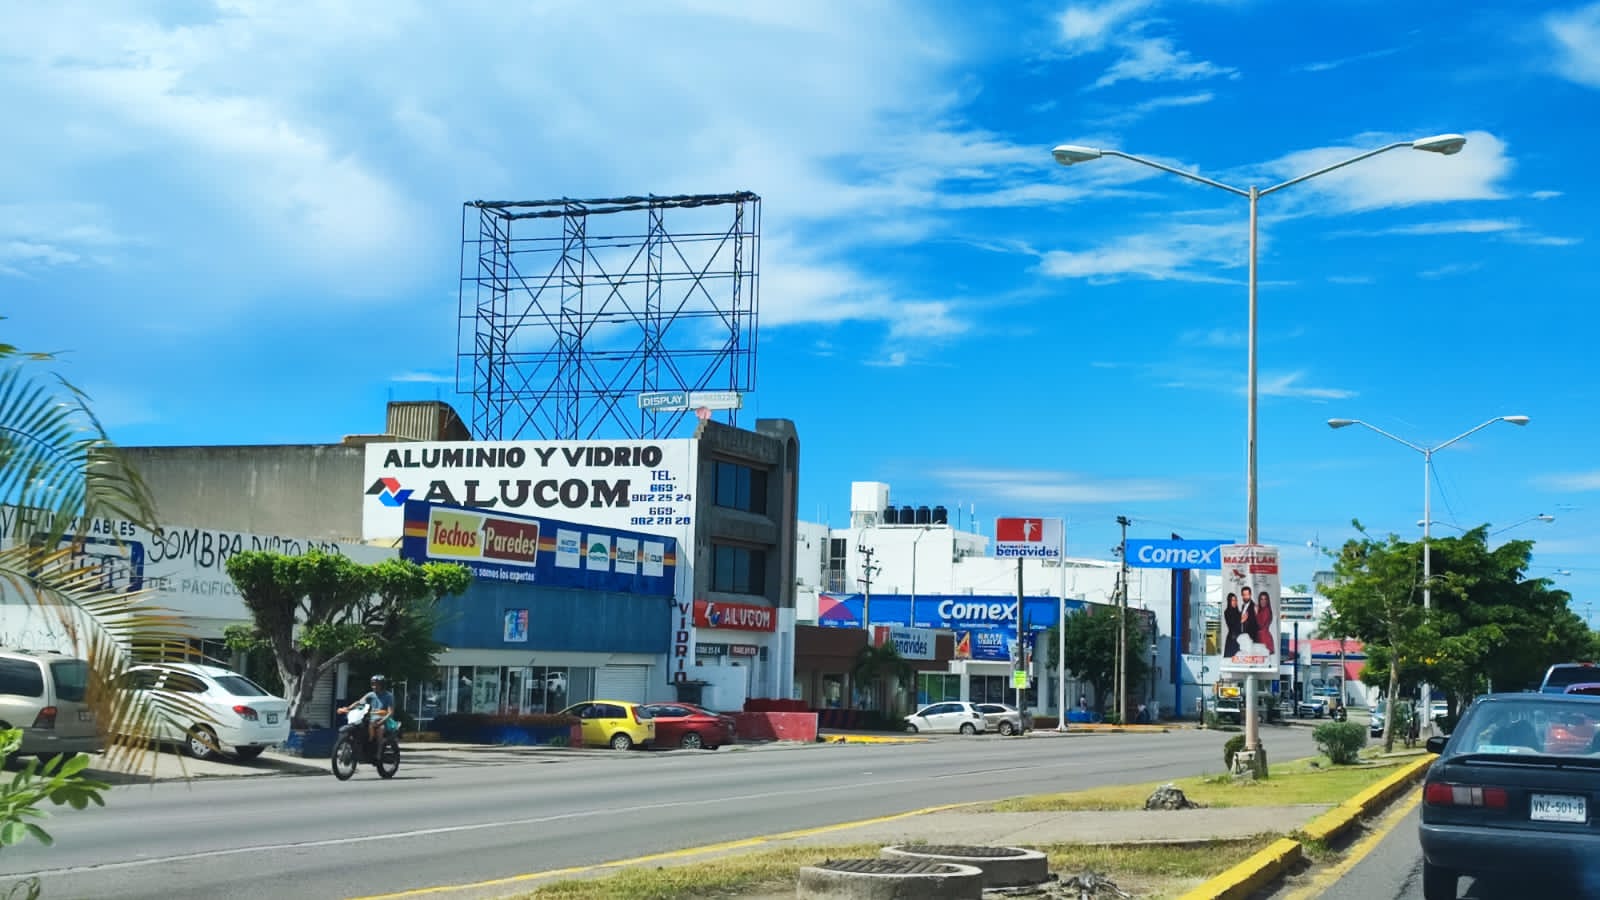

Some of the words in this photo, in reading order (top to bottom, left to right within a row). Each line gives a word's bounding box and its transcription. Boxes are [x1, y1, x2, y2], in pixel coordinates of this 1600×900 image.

[643, 395, 683, 406] DISPLAY
[384, 447, 526, 468] ALUMINIO
[535, 447, 557, 467] Y
[562, 445, 663, 468] VIDRIO
[651, 470, 676, 481] TEL.
[424, 478, 630, 508] ALUCOM
[148, 527, 243, 569] SOMBRA
[433, 520, 477, 548] Techos
[486, 527, 535, 555] Paredes
[996, 545, 1059, 557] benavides
[1138, 544, 1220, 564] Comex
[724, 607, 770, 628] ALUCOM
[938, 599, 1018, 620] Comex
[674, 603, 690, 682] VIDRIO
